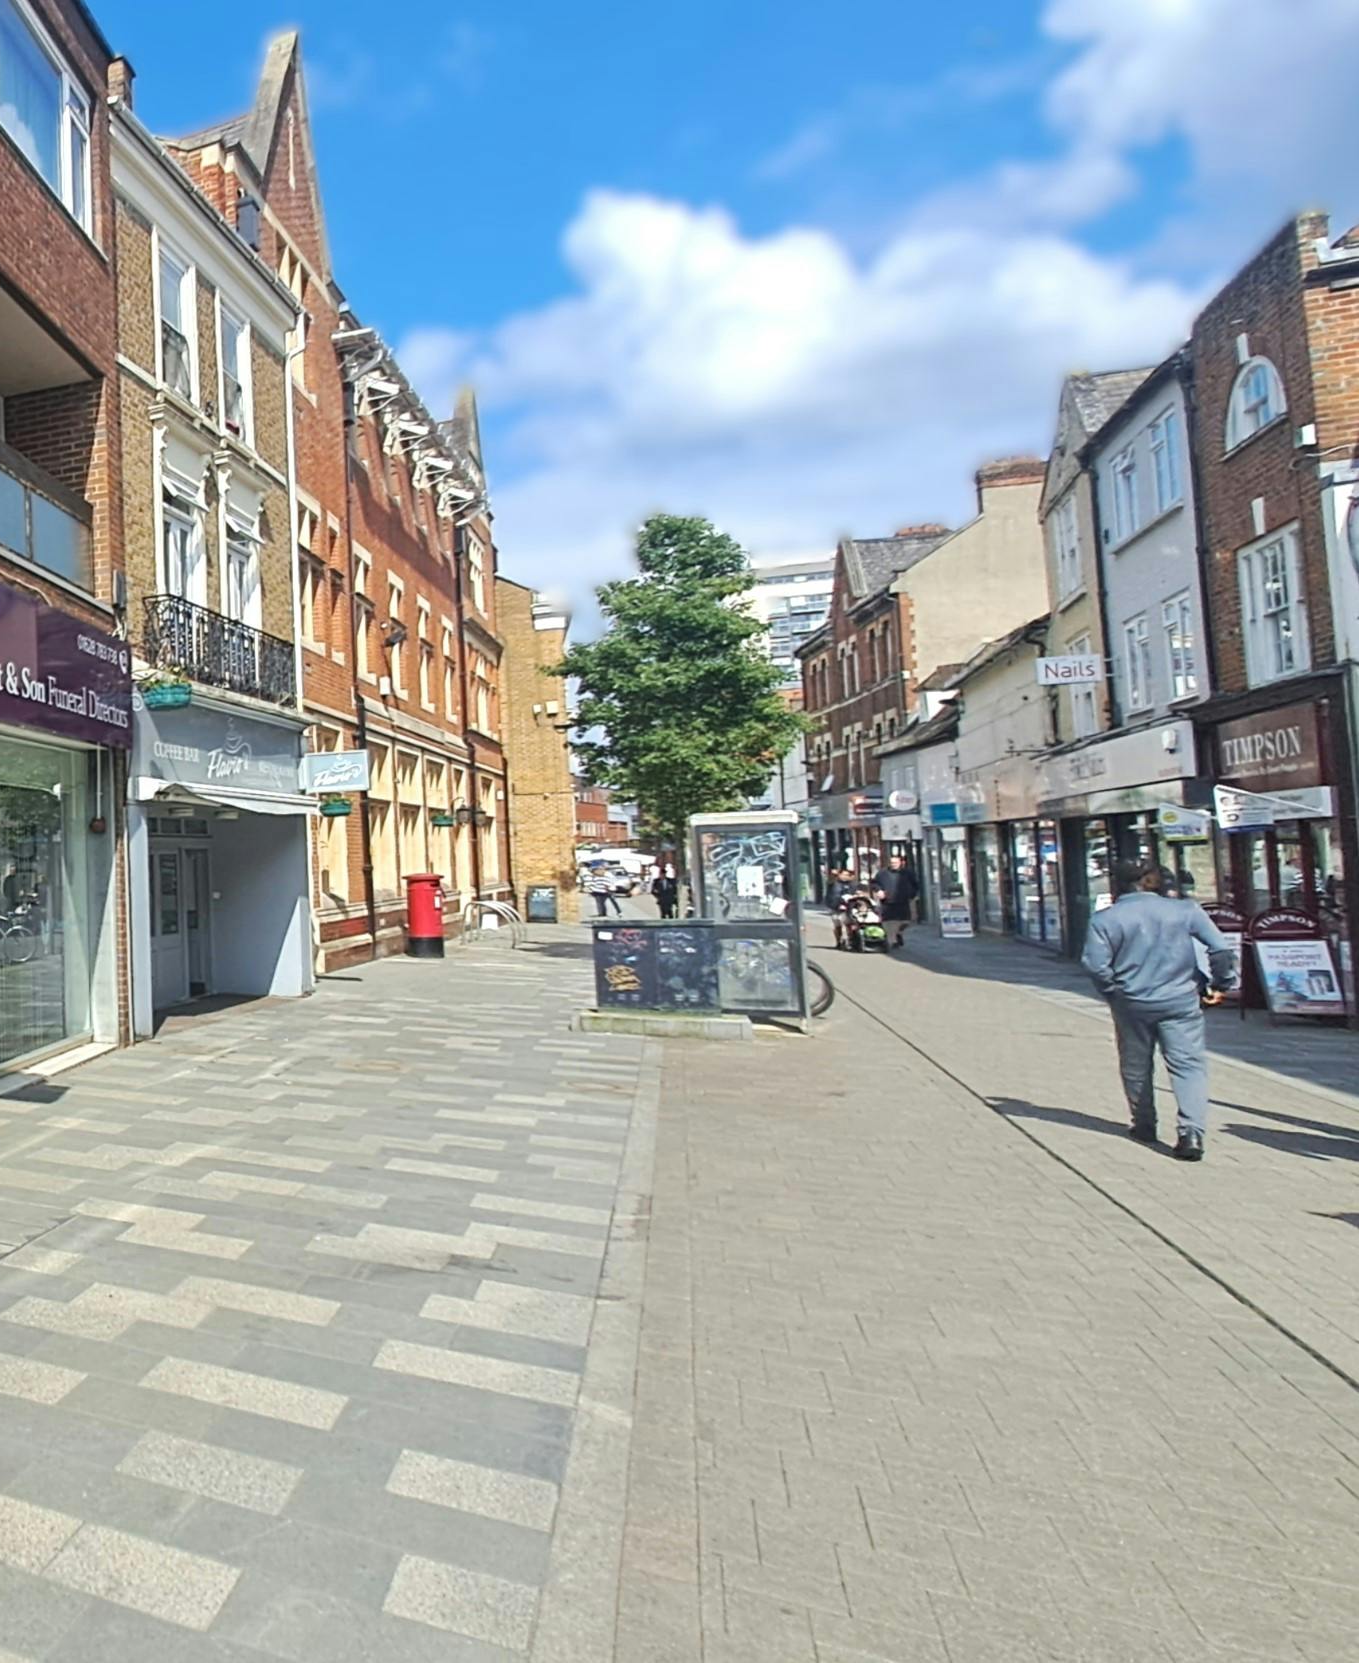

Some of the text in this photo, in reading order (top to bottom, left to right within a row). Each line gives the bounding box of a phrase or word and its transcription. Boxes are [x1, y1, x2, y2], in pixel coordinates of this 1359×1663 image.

[1044, 660, 1096, 679] Nails
[6, 662, 19, 695] &
[22, 667, 46, 702] Son
[47, 675, 87, 717] Funeral
[88, 687, 129, 728] Directors
[1222, 725, 1302, 767] TIMPSON
[1256, 914, 1317, 929] TIMPSON
